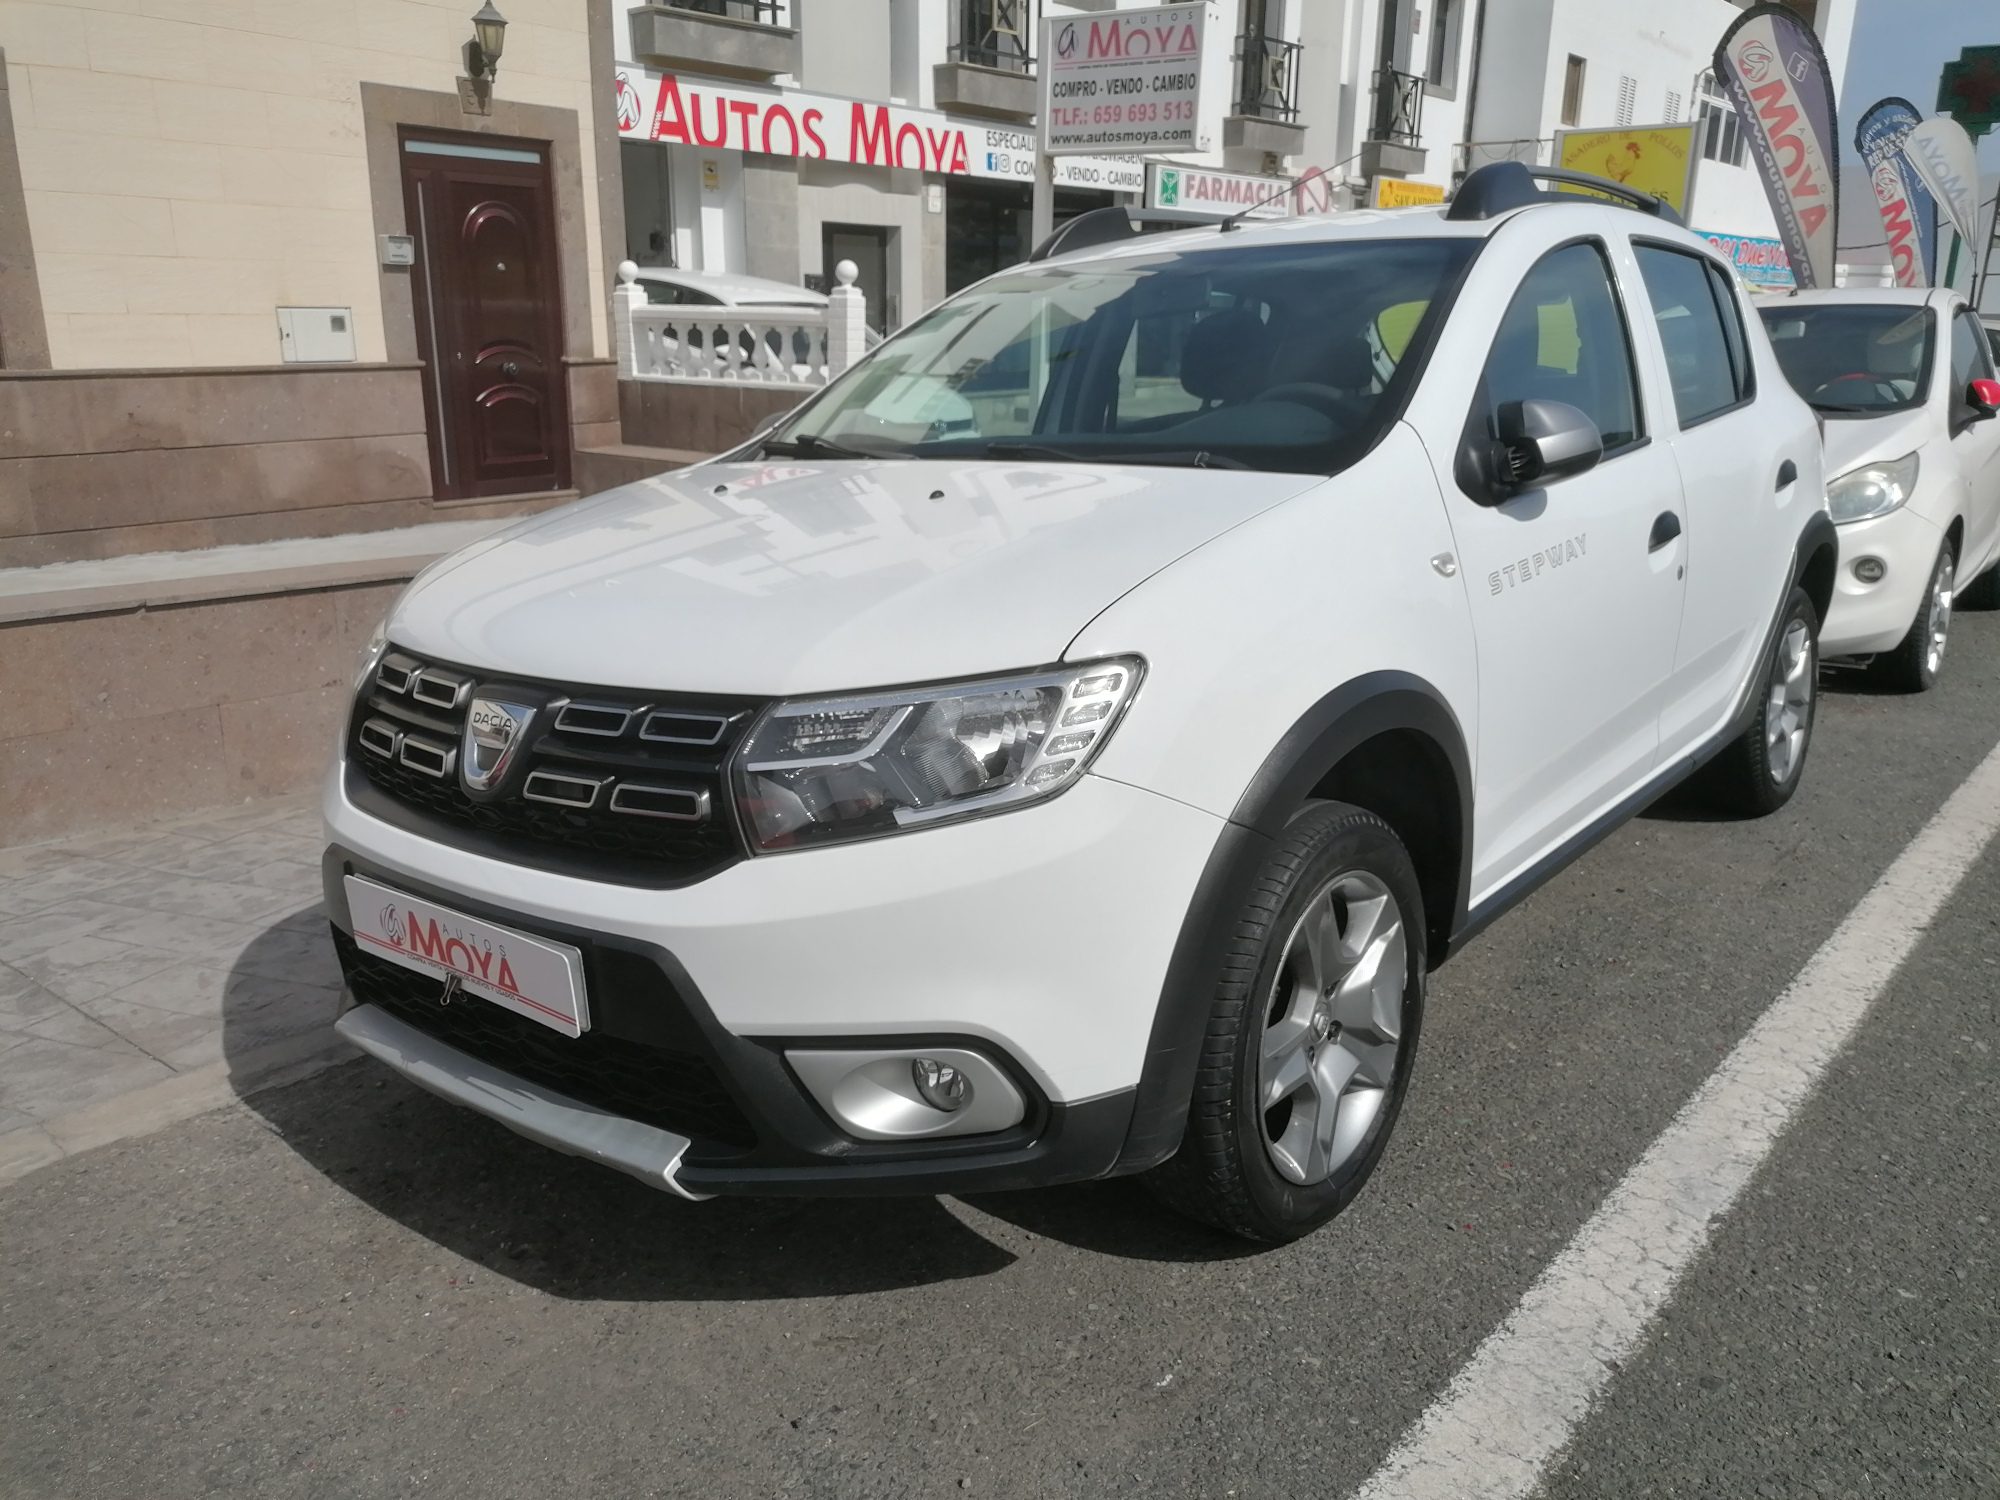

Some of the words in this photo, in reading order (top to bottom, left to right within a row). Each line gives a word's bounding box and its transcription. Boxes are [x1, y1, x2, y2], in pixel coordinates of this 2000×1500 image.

[1125, 11, 1193, 26] AUTOS
[1087, 19, 1197, 59] MOYA
[1053, 80, 1097, 98] COMPRO
[1106, 77, 1143, 95] VENDO
[1152, 73, 1196, 93] CAMBIO
[650, 73, 827, 160] AUTOS
[849, 102, 971, 175] MOYA
[1053, 107, 1088, 126] TLF.:
[1093, 105, 1122, 124] 659
[1128, 103, 1157, 122] 693
[1163, 101, 1193, 121] 513
[1051, 128, 1192, 144] www.autosmoya.com
[1749, 78, 1828, 239] MOYA
[1066, 166, 1099, 182] VENDO
[1107, 170, 1143, 187] CAMBIO
[1184, 174, 1286, 208] FARMACIA
[1487, 533, 1586, 596] STEPWAY
[473, 711, 513, 731] DACIA
[408, 910, 519, 994] MOYA
[443, 923, 507, 958] AUTOS
